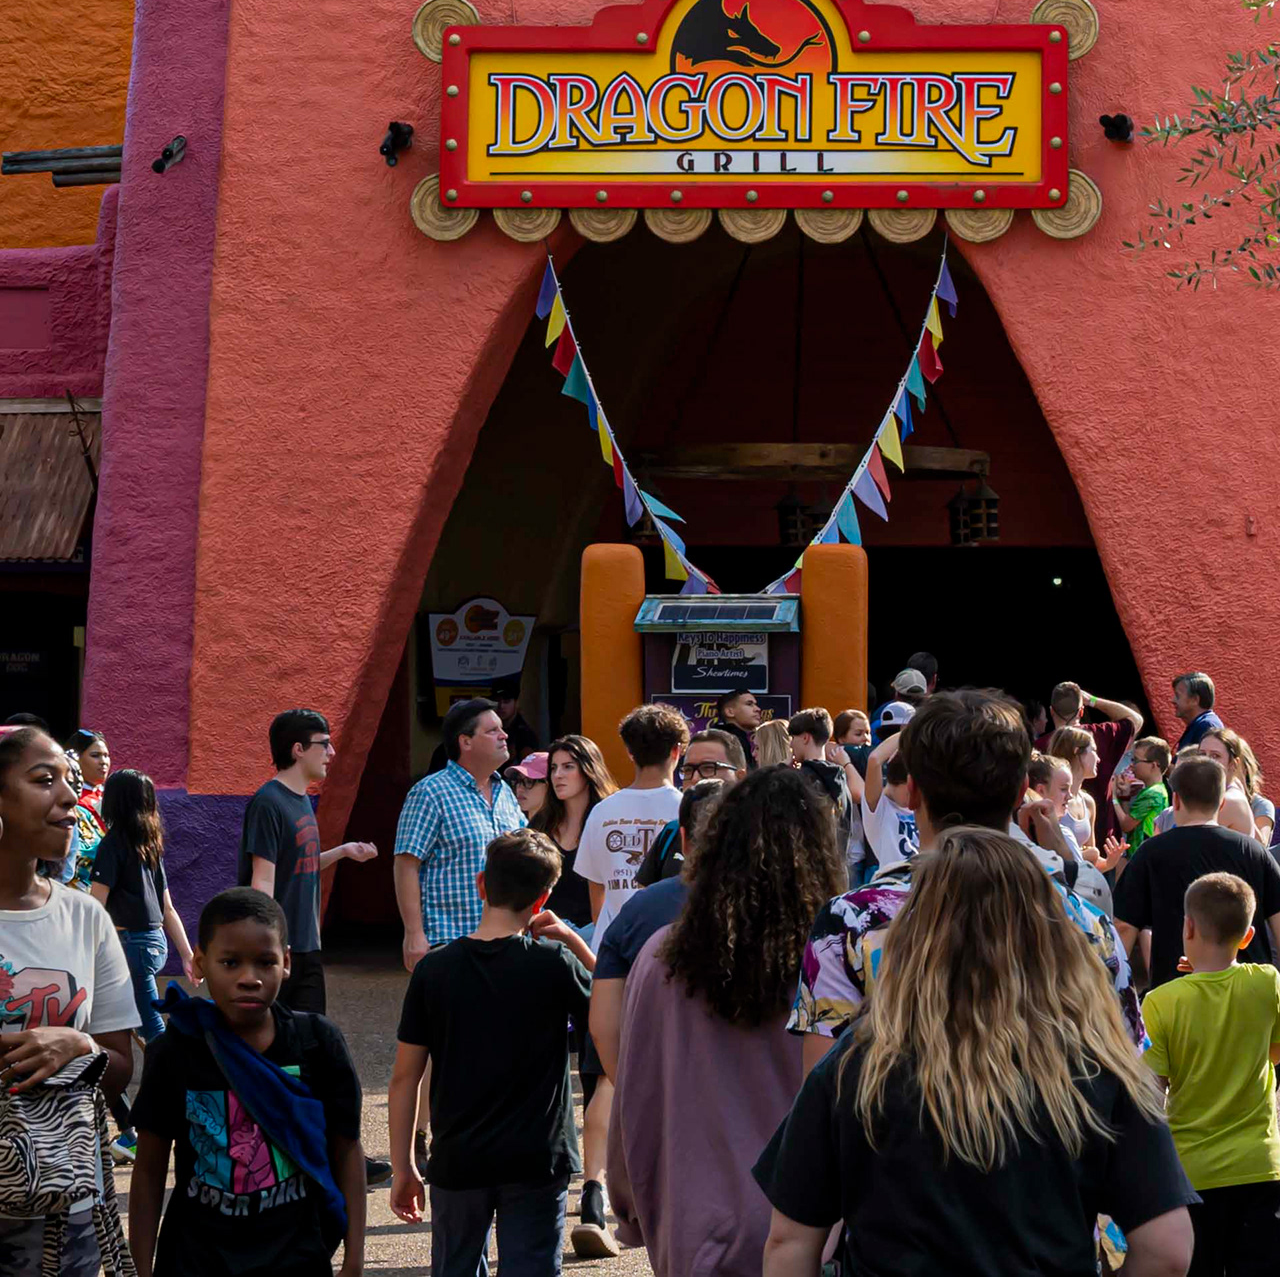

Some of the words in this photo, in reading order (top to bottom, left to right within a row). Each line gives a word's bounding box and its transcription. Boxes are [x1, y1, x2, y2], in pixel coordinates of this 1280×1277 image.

[487, 72, 812, 156] DRAGON
[827, 72, 1018, 167] FIRE
[676, 151, 834, 173] GRILL
[697, 648, 719, 658] Piano
[720, 648, 745, 658] Artist
[692, 666, 748, 678] Showtimes
[613, 869, 632, 877] (951)
[187, 1176, 251, 1216] SUPER
[259, 1173, 307, 1213] MARI
